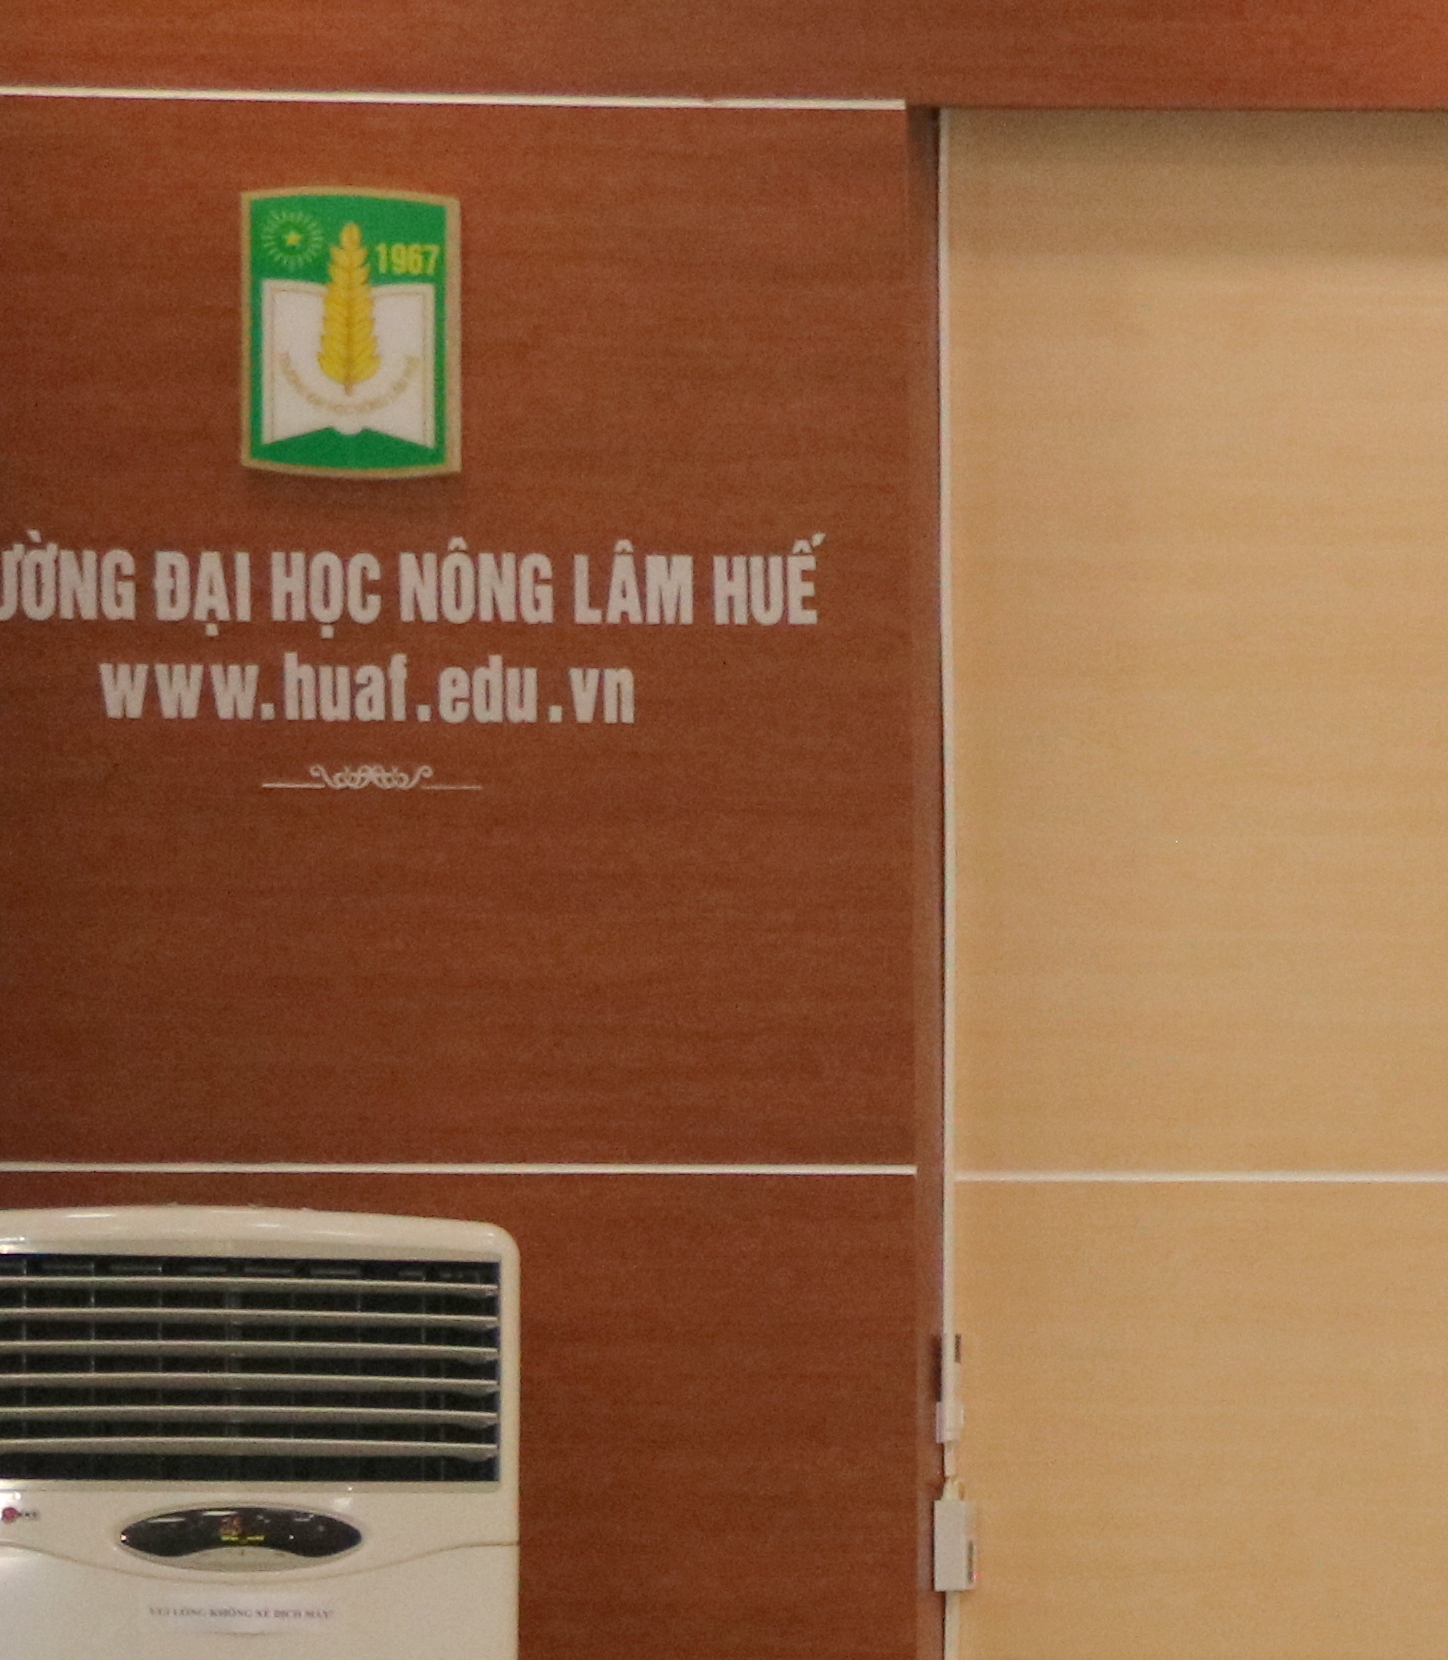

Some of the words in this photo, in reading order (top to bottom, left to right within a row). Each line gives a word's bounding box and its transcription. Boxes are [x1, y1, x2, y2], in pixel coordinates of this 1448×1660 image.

[375, 242, 439, 276] 1967
[154, 550, 251, 637] ĐẠI
[271, 550, 382, 639] HỌC
[400, 536, 555, 625] NÔNG
[574, 539, 694, 625] LÂM
[713, 532, 827, 625] HUẾ
[99, 651, 636, 725] www.huaf.edu.vn
